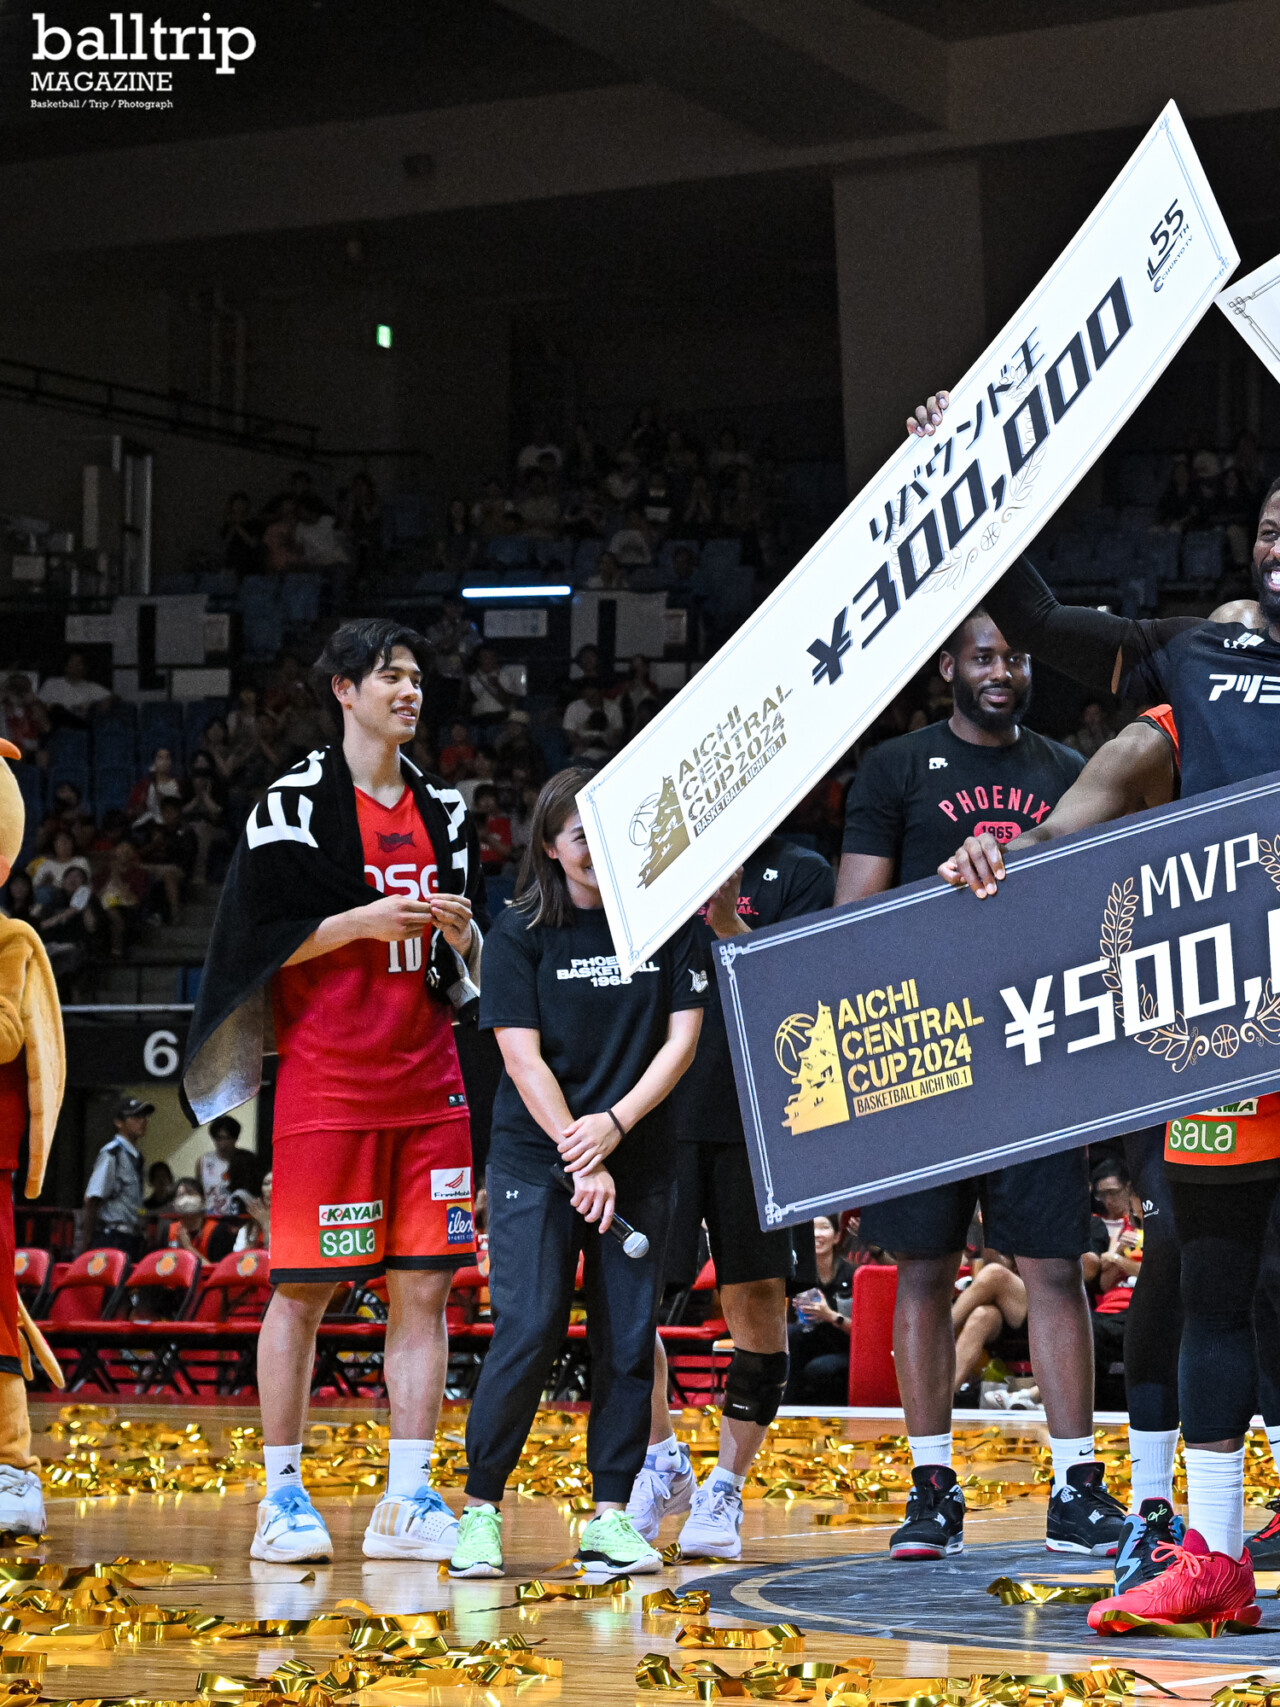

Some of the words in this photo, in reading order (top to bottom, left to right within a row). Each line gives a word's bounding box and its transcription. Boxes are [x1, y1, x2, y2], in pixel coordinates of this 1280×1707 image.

[1150, 198, 1184, 257] 55
[1161, 247, 1186, 281] CHUKYO
[1184, 235, 1193, 248] TV
[868, 326, 1046, 545] リバウンド王
[806, 276, 1133, 686] ¥300,000
[679, 705, 742, 784] AICHI
[682, 685, 793, 800] CENTRAL
[688, 764, 735, 821] CUP
[735, 711, 785, 773] 2024
[696, 779, 746, 834] BASKETBALL
[744, 756, 766, 784] AICHI
[765, 734, 786, 761] NO.1
[938, 785, 1051, 824] PHOENIX
[1141, 832, 1259, 917] MVP
[556, 961, 660, 980] BASKETLL
[570, 955, 619, 969] PHOE
[838, 978, 919, 1030] AICHI
[842, 997, 984, 1060] CENTRAL
[143, 1029, 179, 1078] 6
[848, 1052, 907, 1093] CUP
[908, 1033, 972, 1078] 2024
[857, 1084, 918, 1114] BASKETBALL
[919, 1077, 945, 1097] AICHI
[946, 1070, 969, 1087] NO.1
